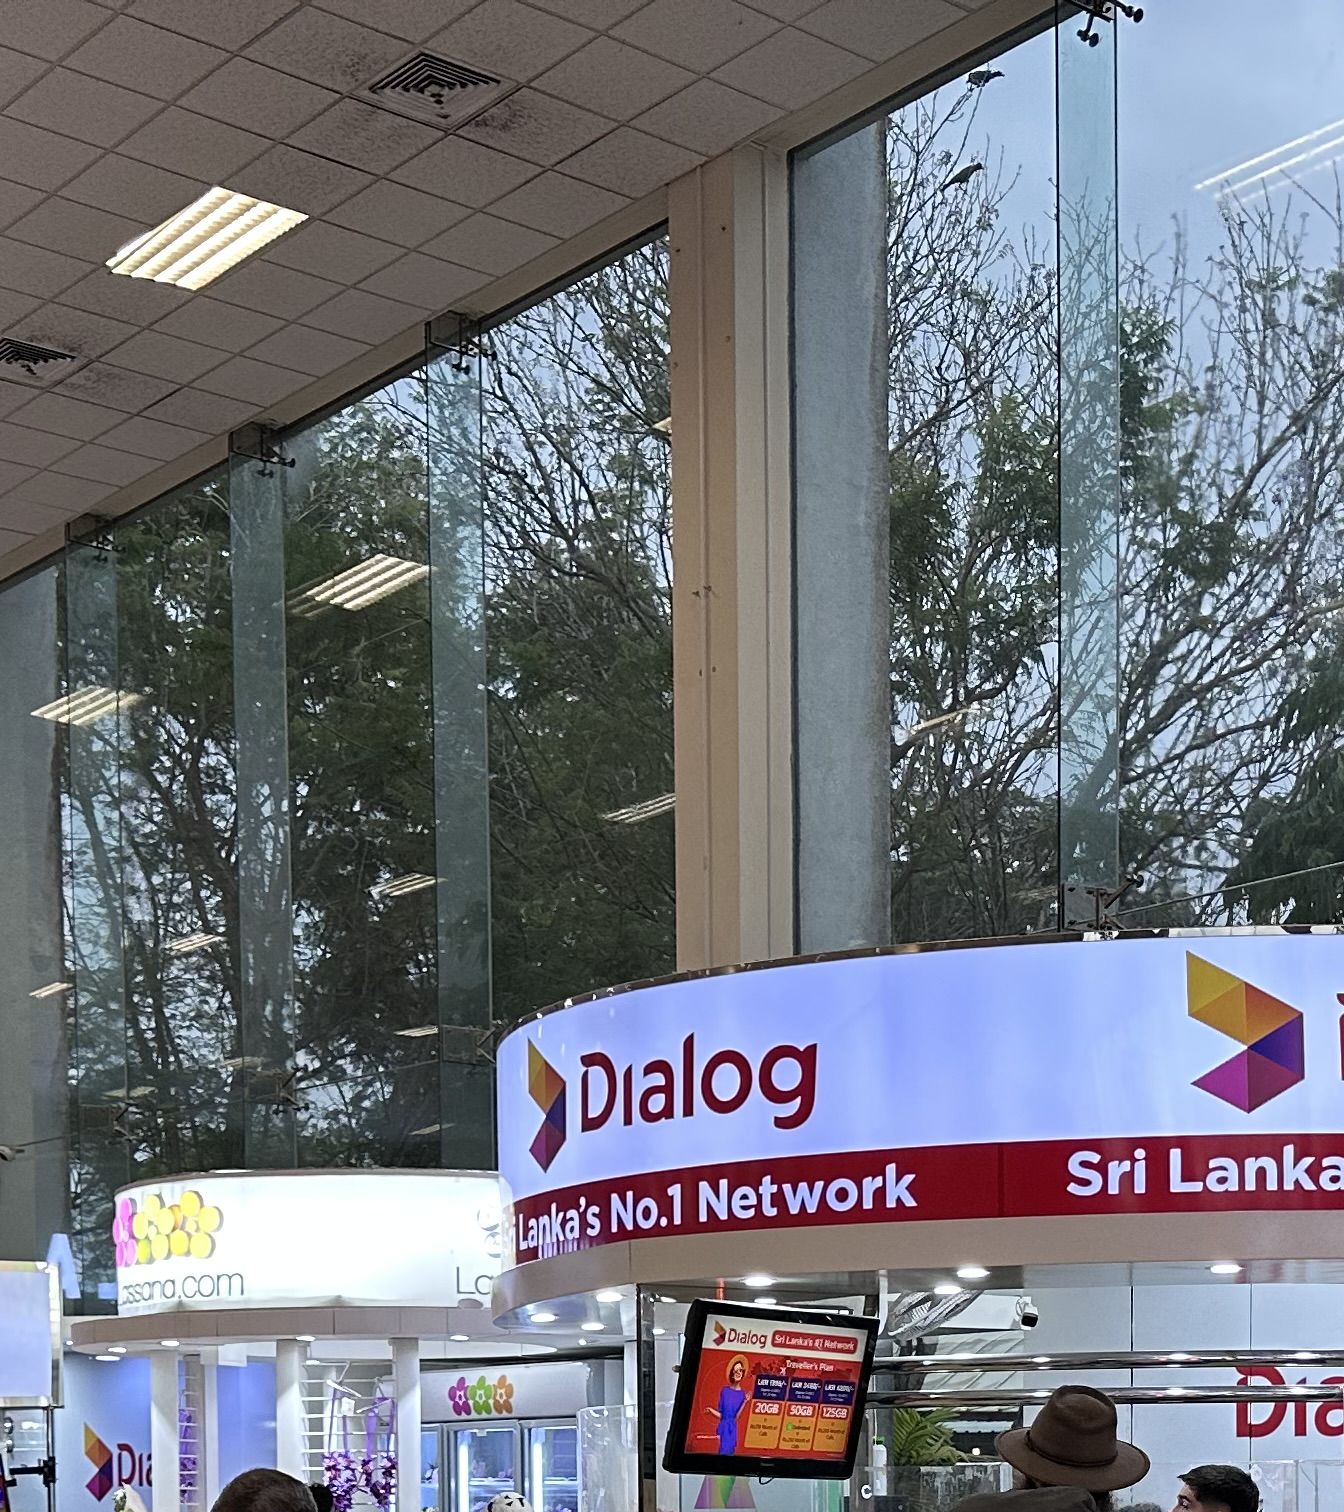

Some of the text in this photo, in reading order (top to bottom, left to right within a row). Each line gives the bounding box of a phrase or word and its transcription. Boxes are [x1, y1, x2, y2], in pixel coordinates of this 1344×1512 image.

[579, 1031, 818, 1133] Dialog
[1066, 1147, 1147, 1196] Sri
[518, 1195, 601, 1251] Lanka's
[610, 1183, 683, 1234] No.1
[697, 1162, 918, 1223] Network
[728, 1327, 768, 1349] Dialog
[755, 1402, 780, 1415] 20GB
[789, 1404, 814, 1417] 50GB
